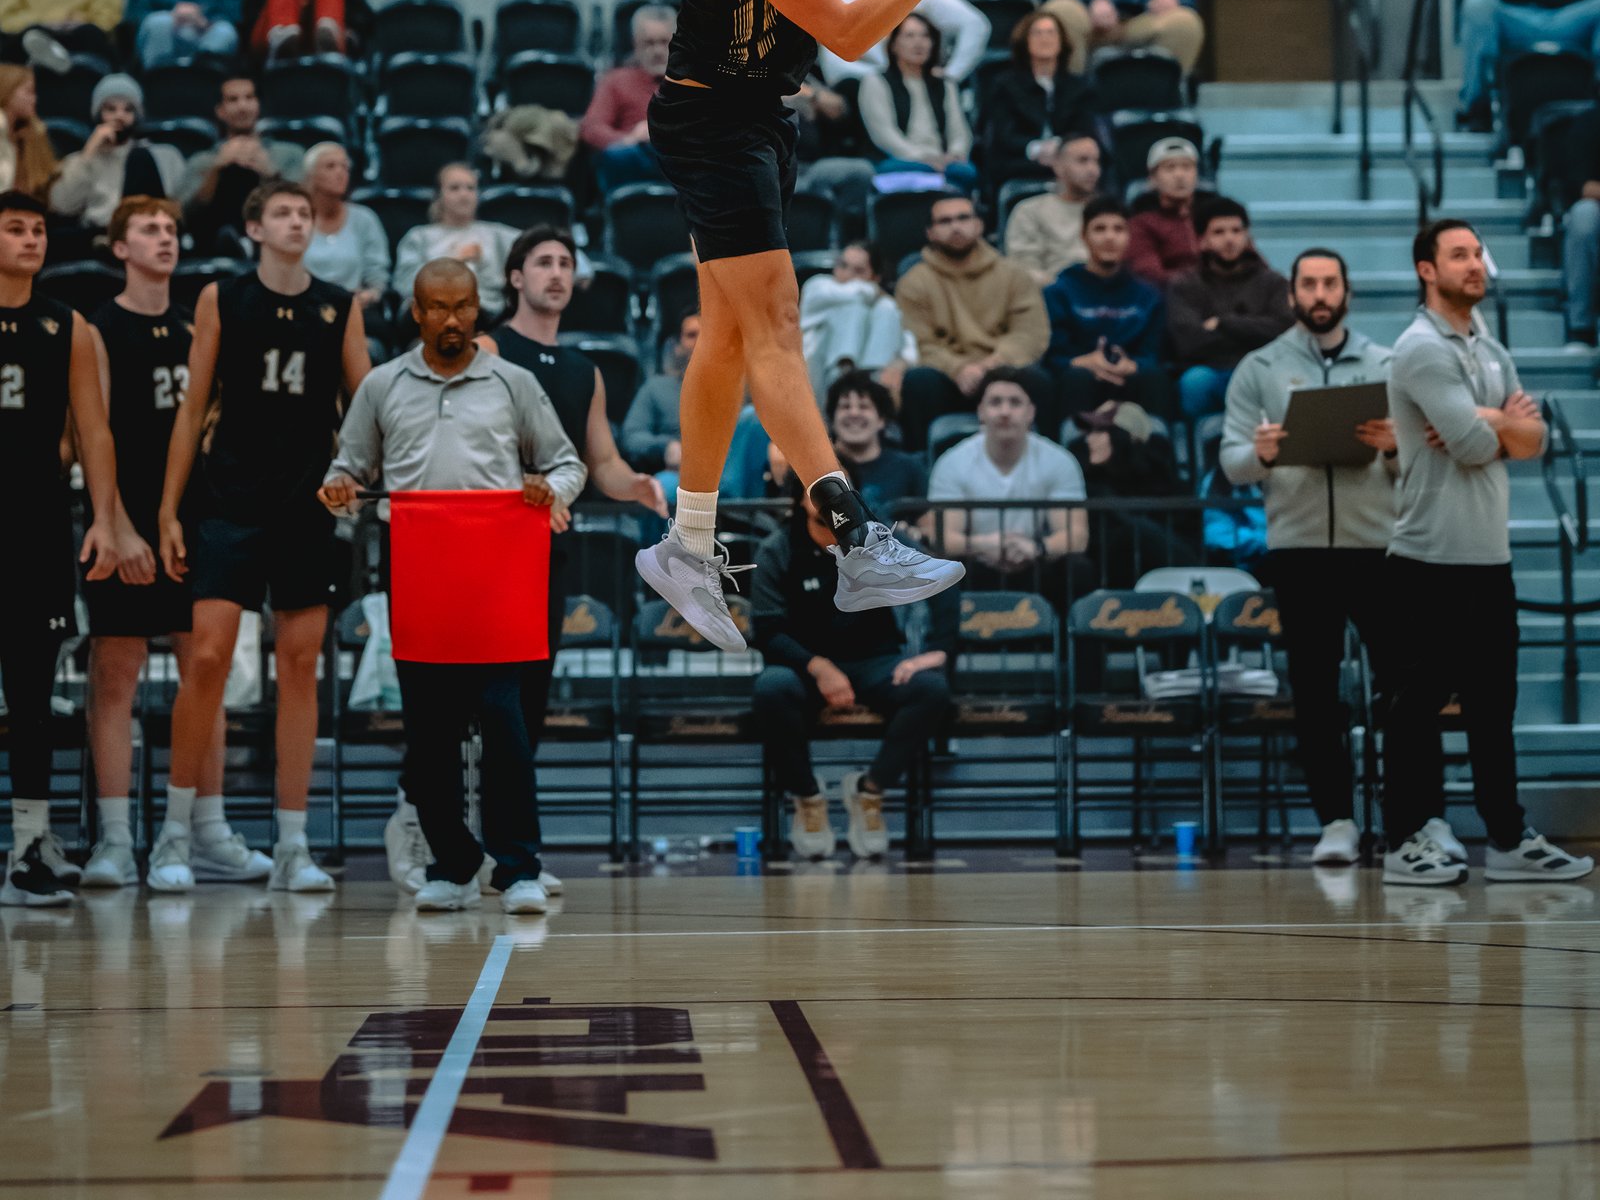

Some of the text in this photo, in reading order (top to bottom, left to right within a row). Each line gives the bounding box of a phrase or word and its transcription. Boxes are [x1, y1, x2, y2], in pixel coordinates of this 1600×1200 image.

[0, 364, 25, 409] 2
[153, 365, 190, 409] 23
[262, 349, 306, 395] 14
